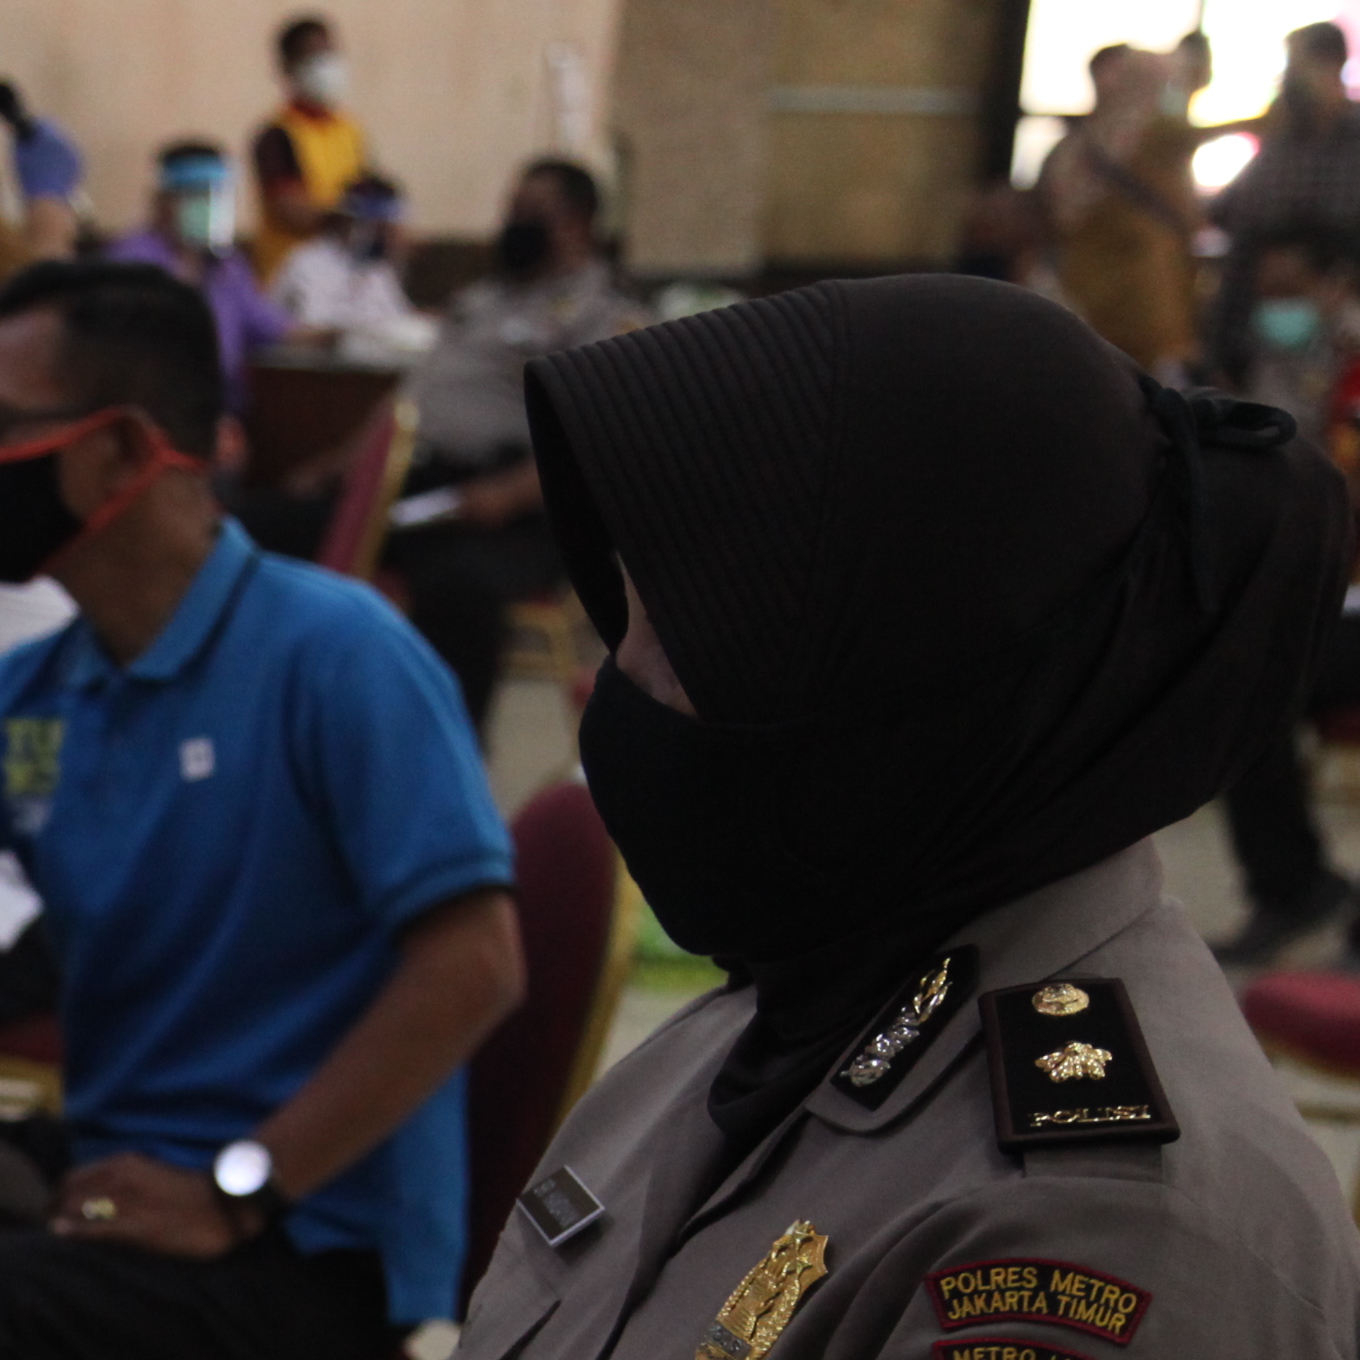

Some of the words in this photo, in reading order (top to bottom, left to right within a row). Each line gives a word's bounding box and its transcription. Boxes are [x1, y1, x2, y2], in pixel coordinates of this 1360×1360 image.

[939, 1266, 1038, 1300] POLRES
[1049, 1269, 1137, 1314] METRO
[947, 1290, 1049, 1320] JAKARTA
[1056, 1295, 1127, 1336] TIMUR
